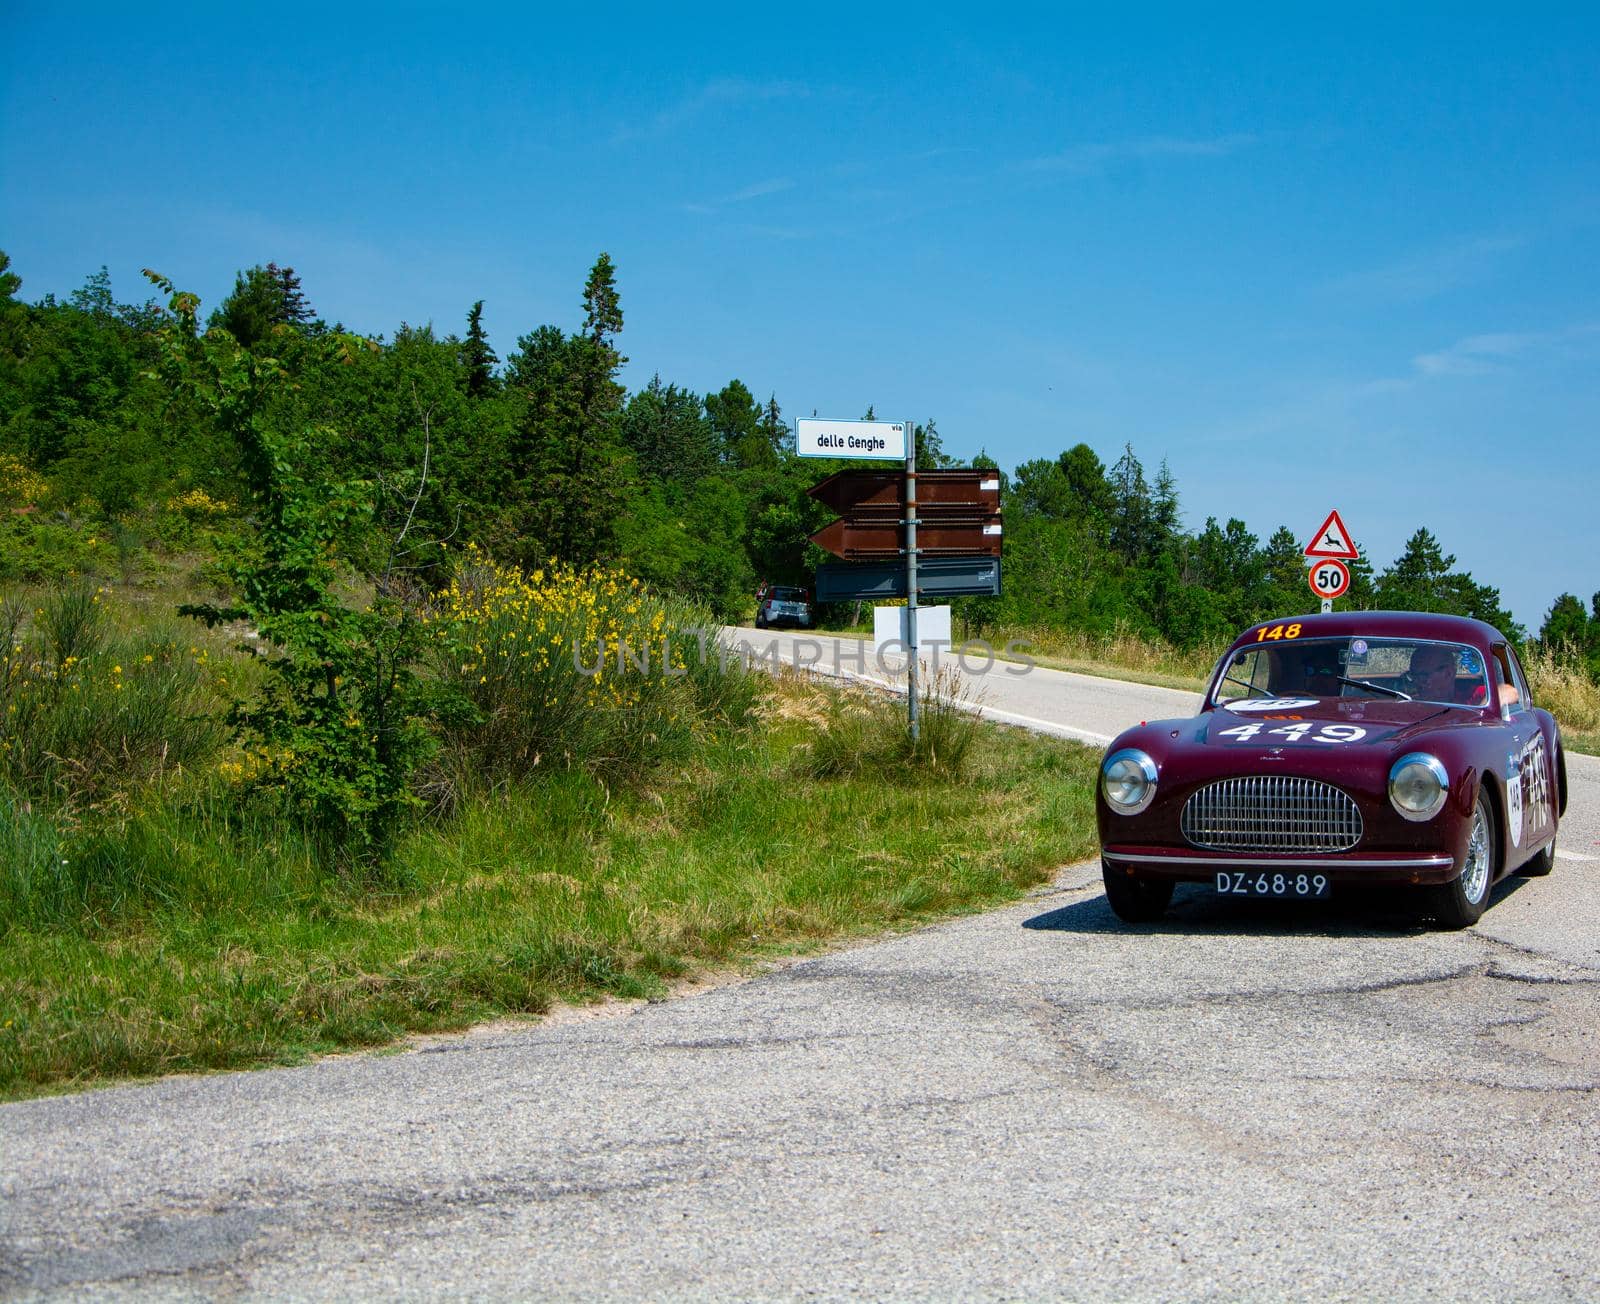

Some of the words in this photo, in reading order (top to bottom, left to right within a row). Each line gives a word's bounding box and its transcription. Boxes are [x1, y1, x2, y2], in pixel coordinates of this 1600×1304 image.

[817, 434, 844, 448] delle
[847, 436, 885, 451] Genghe
[1318, 570, 1341, 589] 50
[1257, 623, 1302, 642] 148
[1218, 723, 1367, 743] 449
